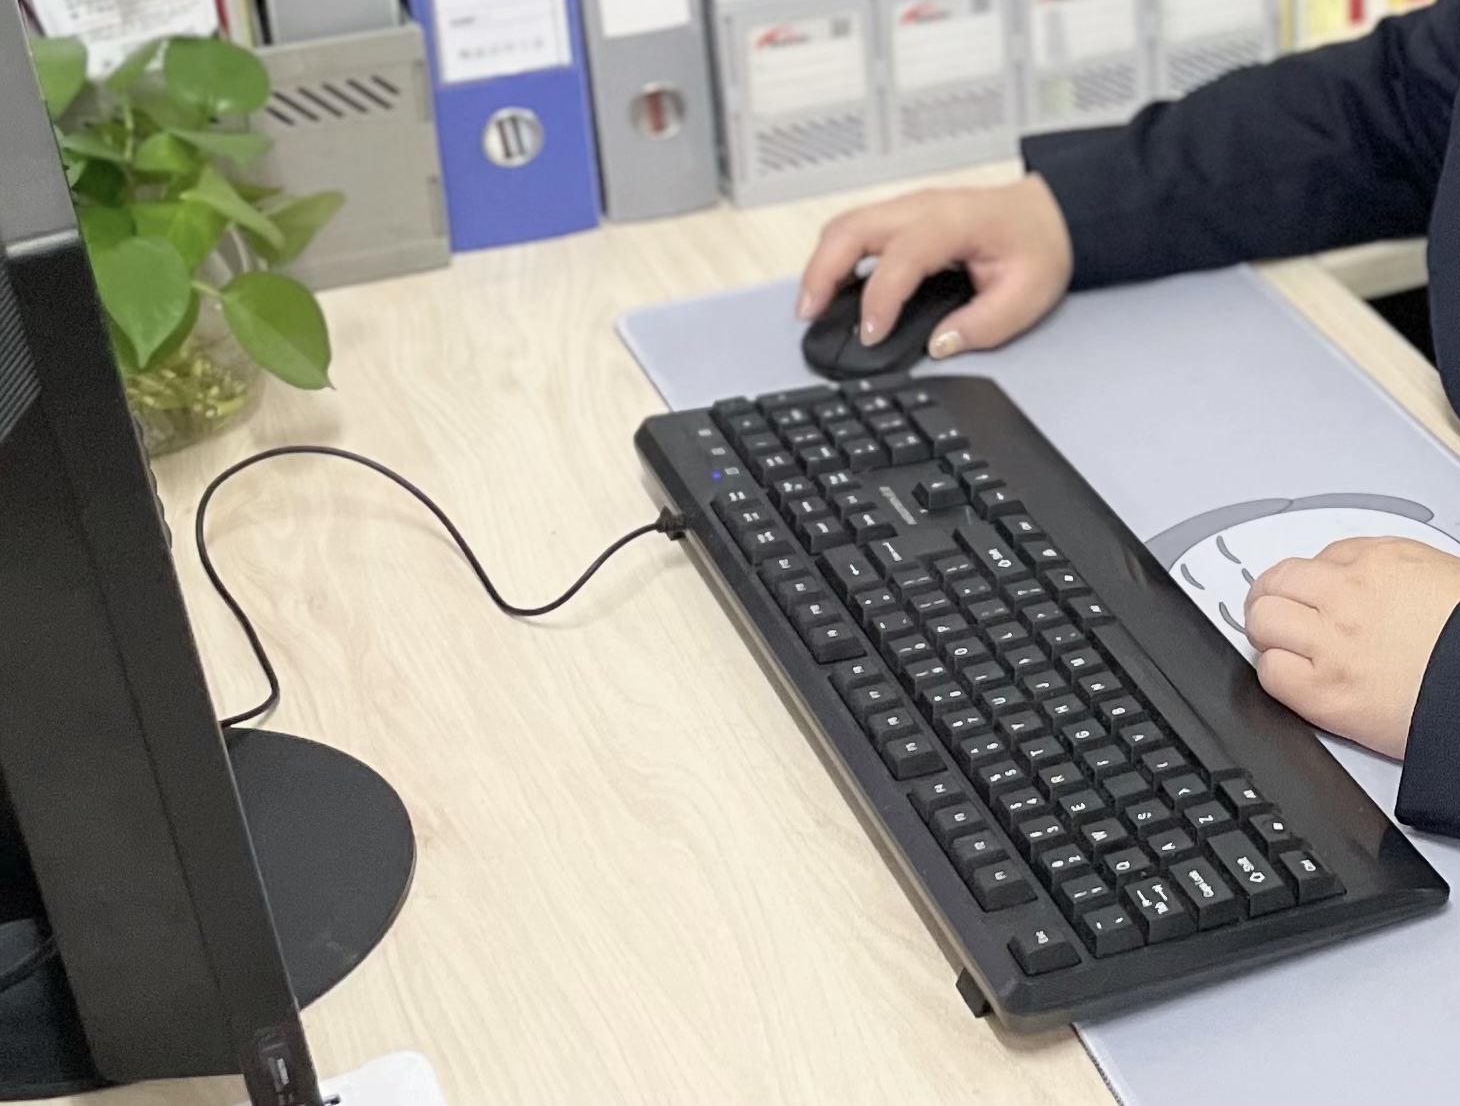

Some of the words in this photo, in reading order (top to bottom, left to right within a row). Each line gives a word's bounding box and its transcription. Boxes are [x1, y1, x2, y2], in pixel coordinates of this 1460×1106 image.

[1071, 658, 1085, 666] M
[992, 697, 1006, 705] U
[1055, 705, 1069, 713] H
[1051, 775, 1065, 783] R
[1071, 803, 1086, 811] E
[1138, 812, 1152, 820] S
[1199, 815, 1214, 824] Z
[1091, 831, 1107, 841] W
[1162, 842, 1176, 850] A
[1068, 855, 1081, 863] 2
[1116, 861, 1130, 870] Q
[1036, 931, 1049, 944] Esc
